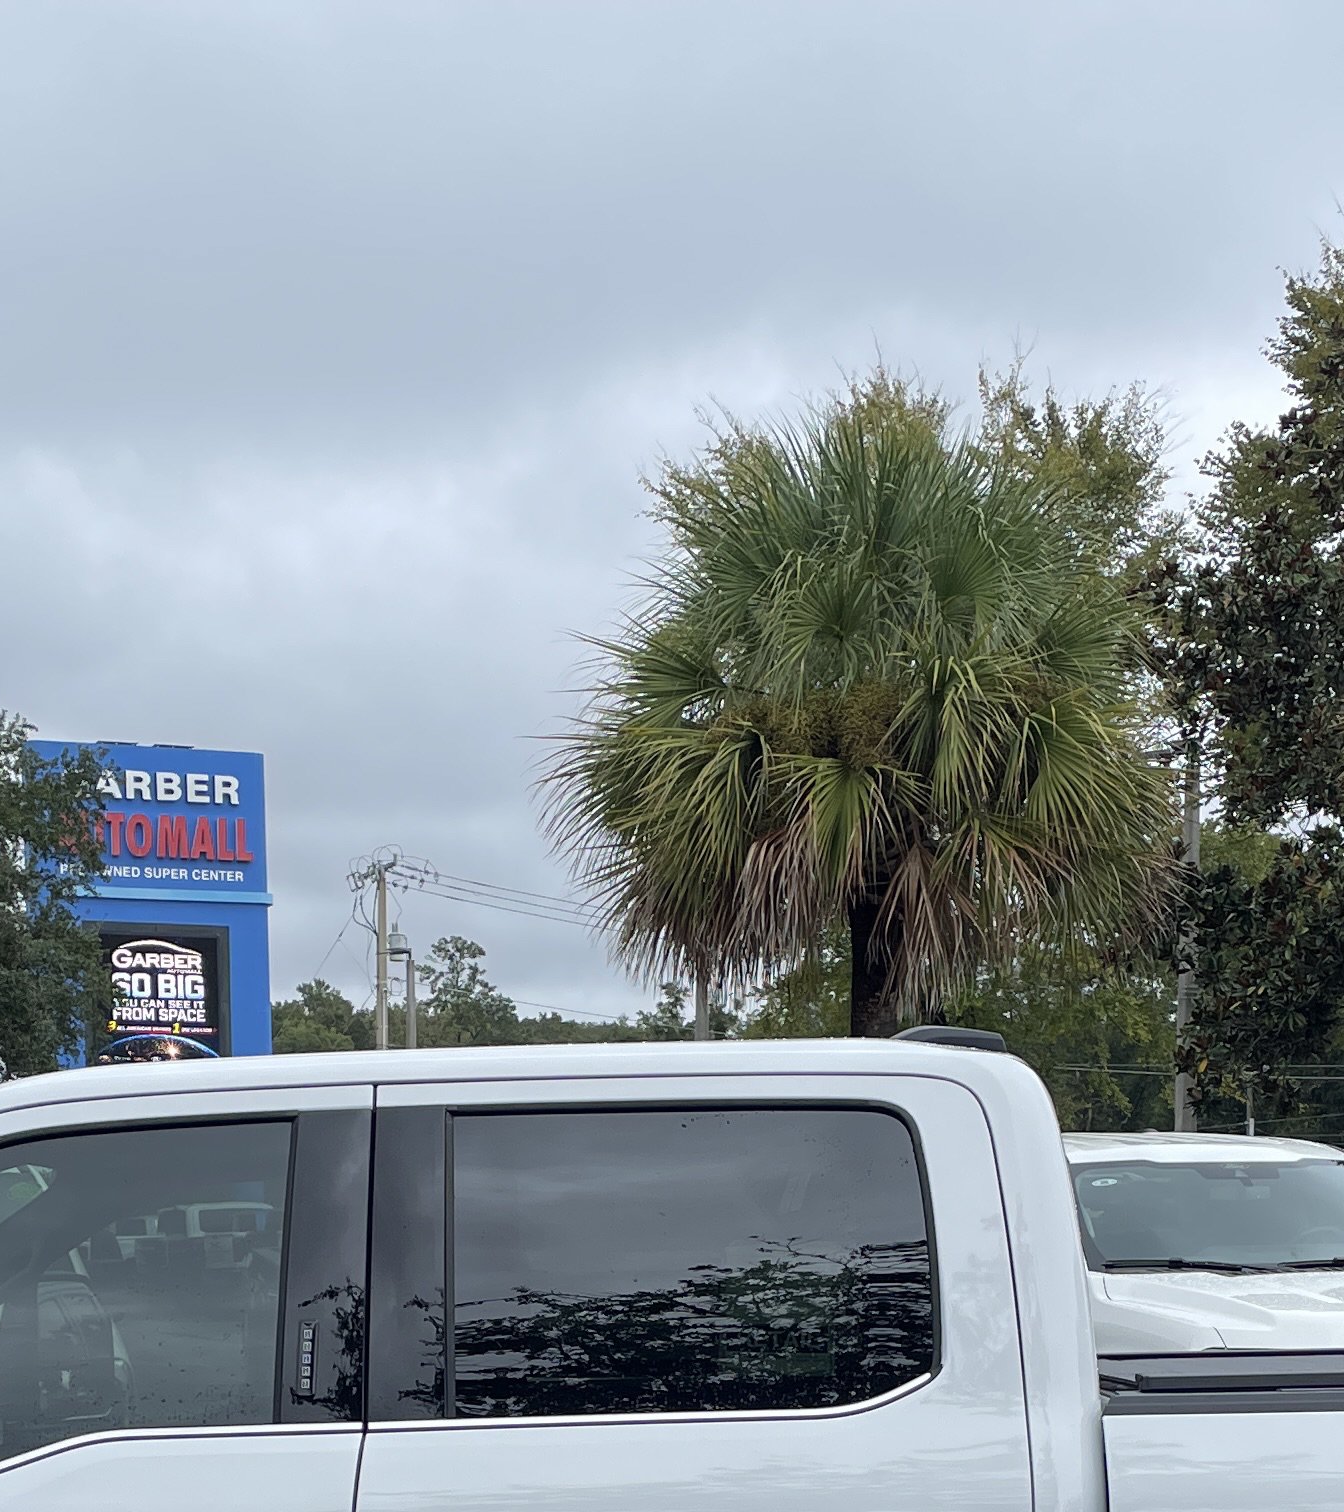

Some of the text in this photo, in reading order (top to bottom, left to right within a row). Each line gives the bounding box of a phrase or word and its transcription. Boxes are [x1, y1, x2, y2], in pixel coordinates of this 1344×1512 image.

[76, 769, 240, 805] ARBER
[60, 811, 254, 862] TOMALL
[143, 866, 189, 881] SUPER
[191, 868, 244, 882] CENTER
[111, 948, 203, 970] GARBER
[111, 972, 205, 1000] SO BIG
[112, 1007, 207, 1023] FROM SPACE
[141, 999, 165, 1009] CAN
[168, 1000, 192, 1009] SEE
[193, 1000, 205, 1010] IT
